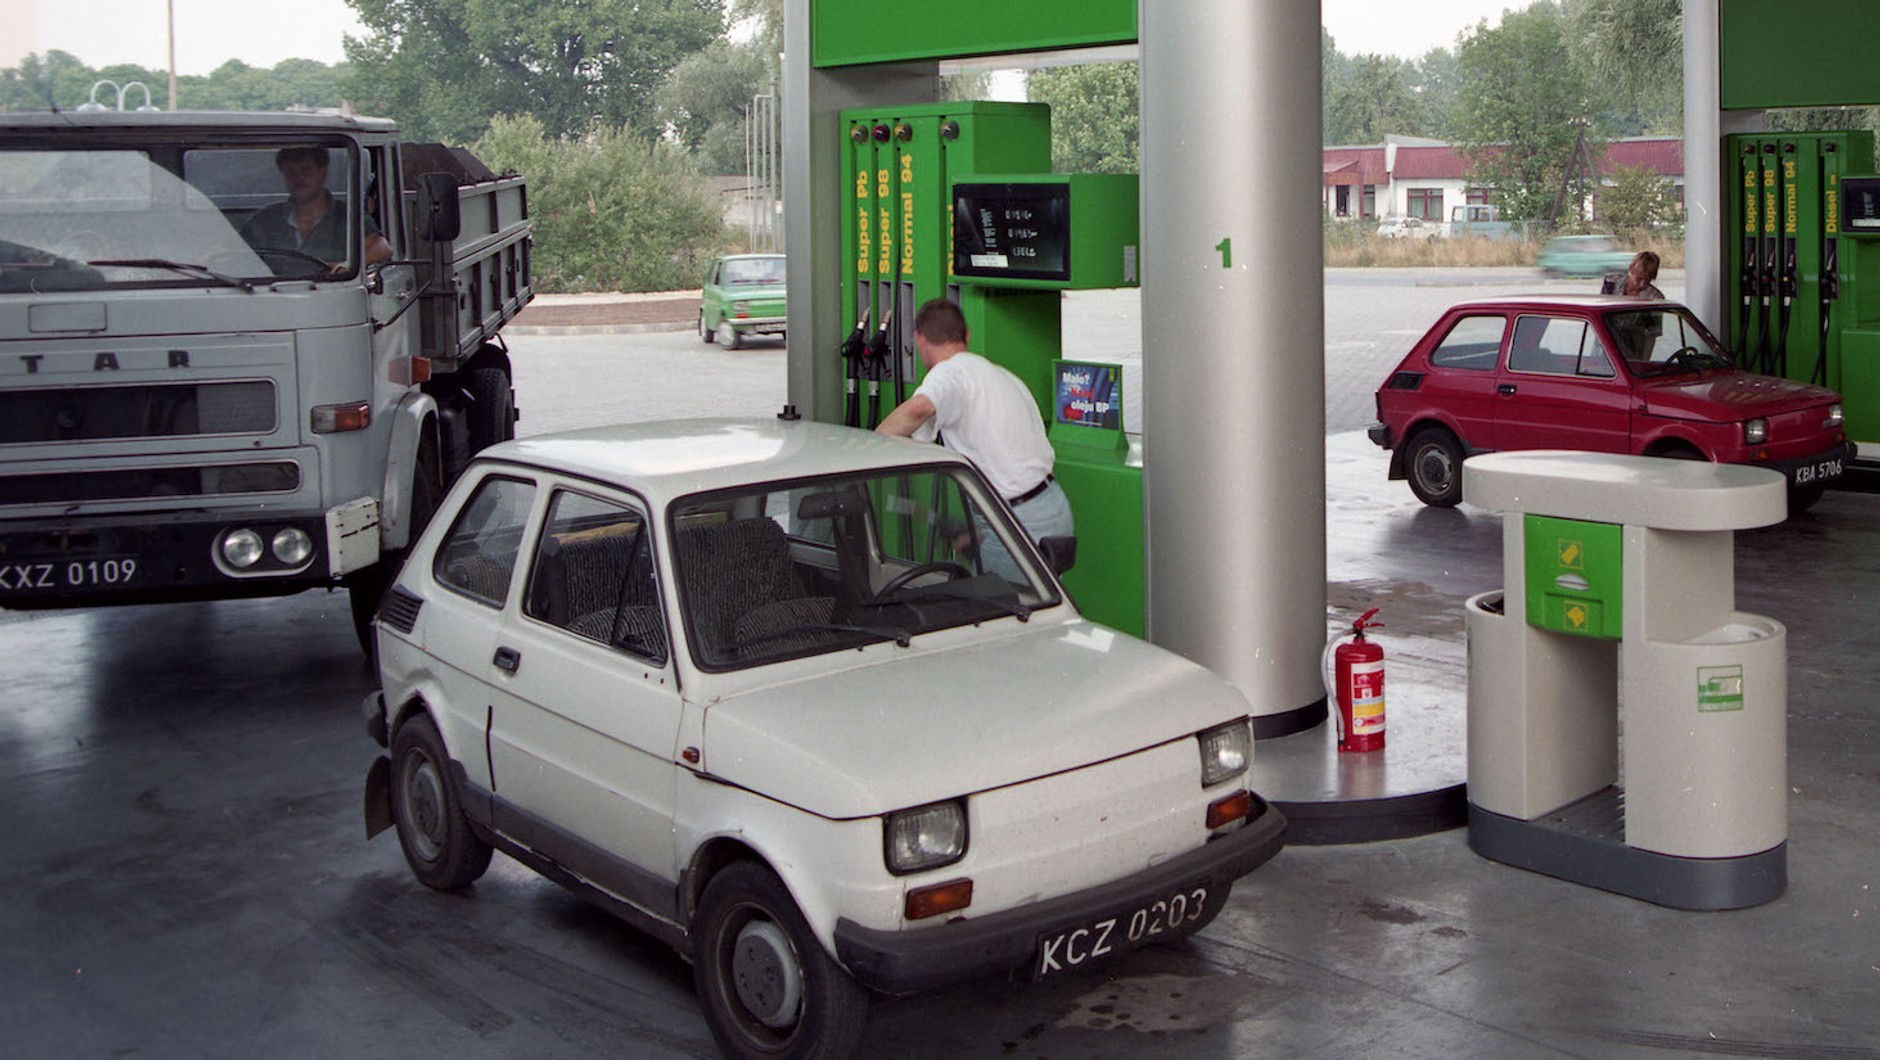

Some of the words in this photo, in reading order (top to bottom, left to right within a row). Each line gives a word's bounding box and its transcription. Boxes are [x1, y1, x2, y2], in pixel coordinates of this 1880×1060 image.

[856, 170, 868, 198] Pb
[878, 169, 889, 198] 98
[901, 153, 912, 183] 94
[1745, 192, 1757, 232] Super
[1765, 192, 1776, 232] Super
[1785, 184, 1796, 232] Normal
[857, 207, 870, 273] Super
[878, 207, 892, 274] Super
[901, 192, 913, 274] Normal
[1215, 238, 1231, 268] 1
[1096, 401, 1109, 413] BP
[1796, 465, 1816, 483] KBA
[1818, 459, 1842, 478] 5706
[0, 565, 54, 589] KXZ
[68, 560, 136, 585] 0109
[1041, 919, 1117, 974] KCZ
[1128, 888, 1207, 941] 0203
